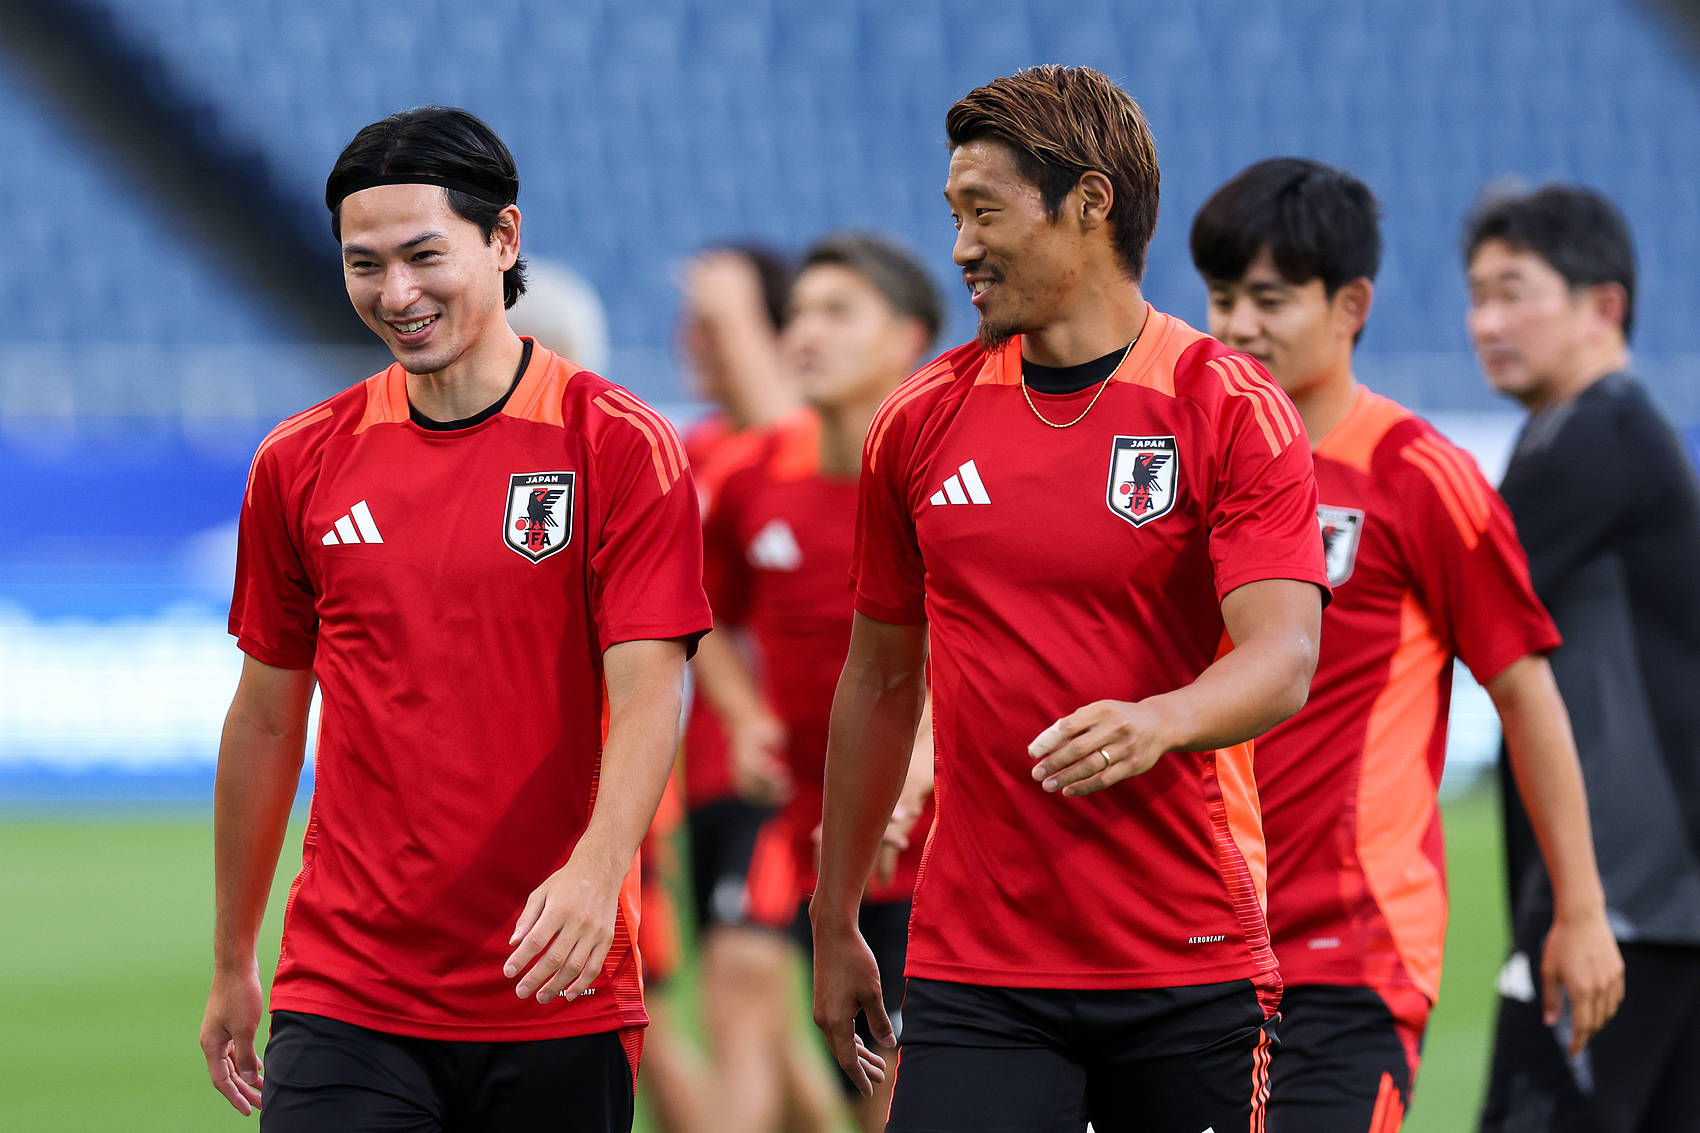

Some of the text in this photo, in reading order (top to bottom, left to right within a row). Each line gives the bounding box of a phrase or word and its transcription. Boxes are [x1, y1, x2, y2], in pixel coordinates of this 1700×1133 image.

[1131, 440, 1165, 448] JAPAN
[526, 475, 559, 484] JAPAN
[1124, 497, 1154, 510] JFA
[520, 532, 551, 546] JFA
[1189, 935, 1225, 944] AEROREADY
[559, 988, 596, 997] AEADY
